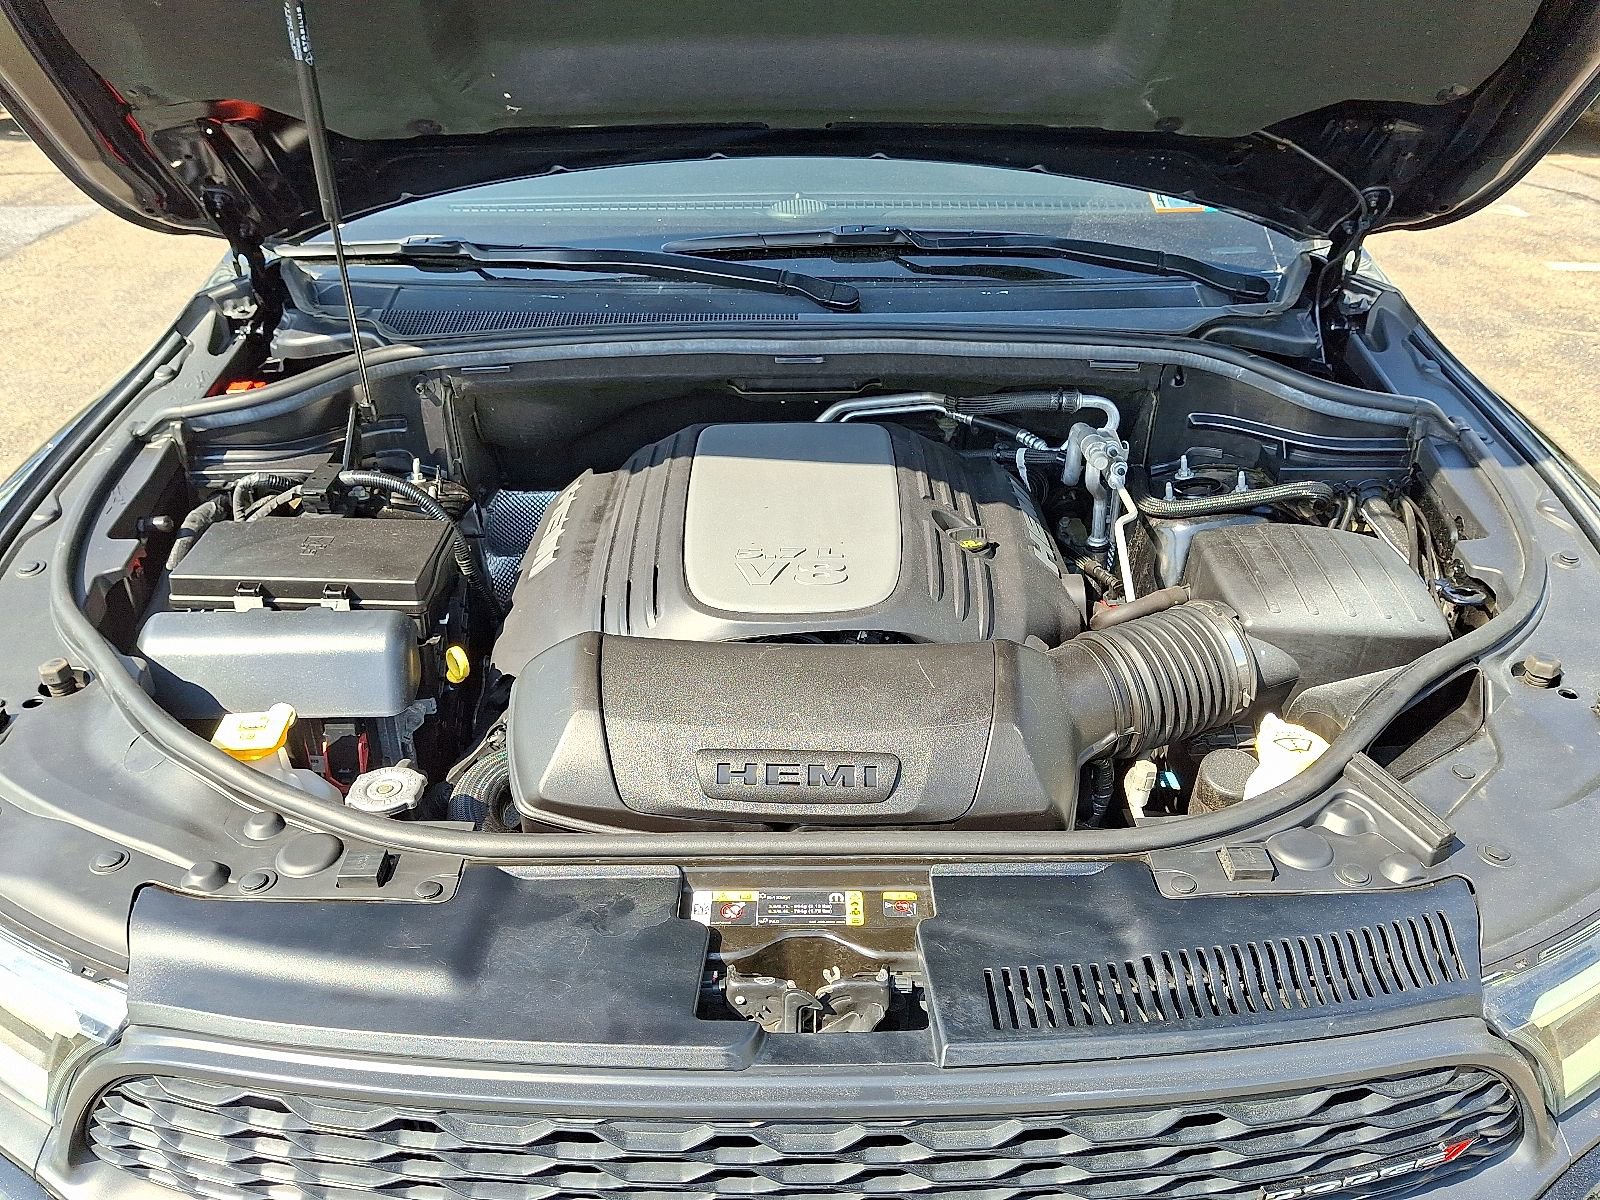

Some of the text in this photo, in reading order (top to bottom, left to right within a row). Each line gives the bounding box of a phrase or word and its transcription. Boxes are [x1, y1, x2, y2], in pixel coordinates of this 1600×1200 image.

[296, 6, 308, 53] STABILUS
[527, 479, 583, 581] HEMI
[734, 561, 849, 585] V8
[716, 762, 878, 788] HEMI
